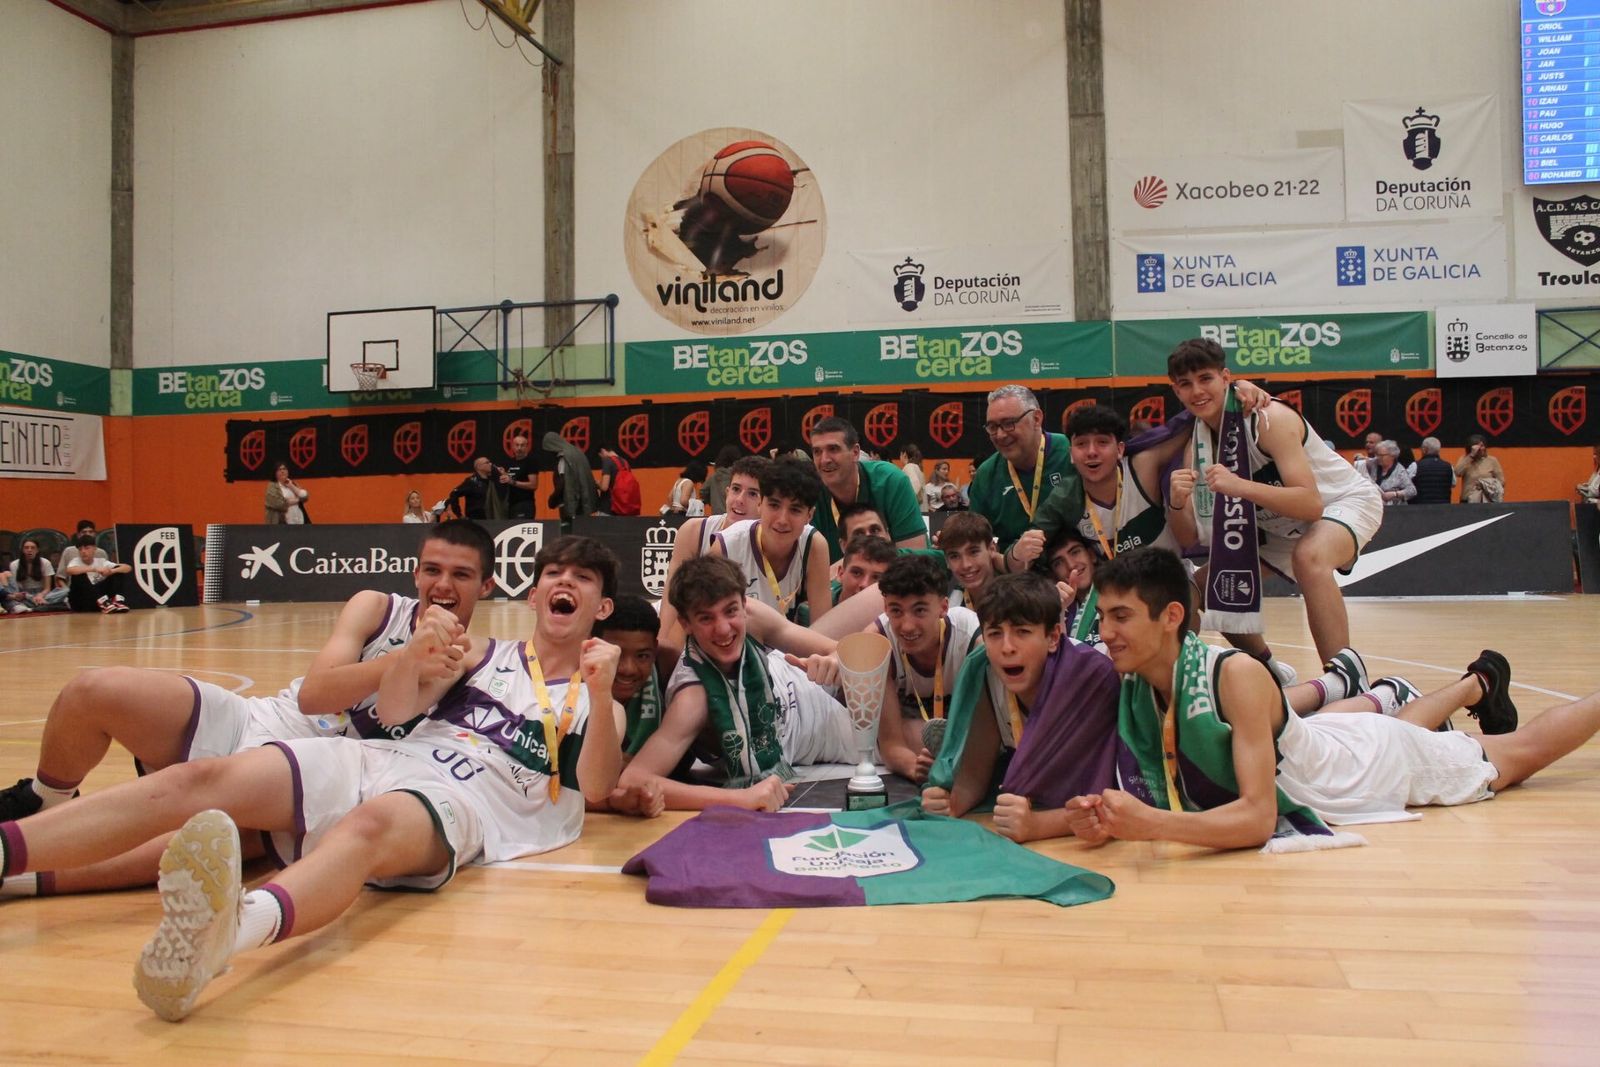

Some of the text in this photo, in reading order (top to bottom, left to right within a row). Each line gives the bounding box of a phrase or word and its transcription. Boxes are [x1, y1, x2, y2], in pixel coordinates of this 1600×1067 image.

[1538, 34, 1572, 43] WILLIAM
[1538, 48, 1561, 56] JOAN
[1538, 60, 1555, 68] JAN
[1538, 72, 1565, 80] JUSTS
[1539, 84, 1568, 92] ARNAU
[1539, 97, 1558, 105] IZAN
[1540, 122, 1564, 130] HUGO
[1540, 134, 1574, 142] CARLOS
[1541, 170, 1582, 179] MOHAMED
[1176, 181, 1269, 201] Xacobeo
[1376, 176, 1471, 198] Deputación
[1376, 193, 1472, 212] DA CORUÑA
[1536, 204, 1568, 213] A.C.D.
[1172, 254, 1236, 270] XUNTA
[1373, 246, 1439, 263] XUNTA
[1172, 271, 1277, 288] DE GALICIA
[1373, 264, 1481, 282] DE GALICIA
[656, 268, 783, 313] viniland
[934, 273, 1020, 292] Deputación
[934, 288, 1021, 306] DA CORUÑA
[691, 316, 756, 326] www.viniland.net
[1200, 322, 1341, 348] BEtanZOS
[880, 330, 1023, 360] BEtanZOS
[672, 340, 808, 370] BEtanZOS
[1236, 346, 1311, 366] cerca
[707, 364, 778, 386] cerca
[916, 356, 992, 377] cerca
[158, 368, 265, 394] BEtanZOS
[184, 390, 241, 409] cerca
[160, 532, 176, 540] FEB
[521, 527, 539, 535] FEB
[1116, 535, 1142, 553] caja
[290, 547, 418, 576] CaixaBan
